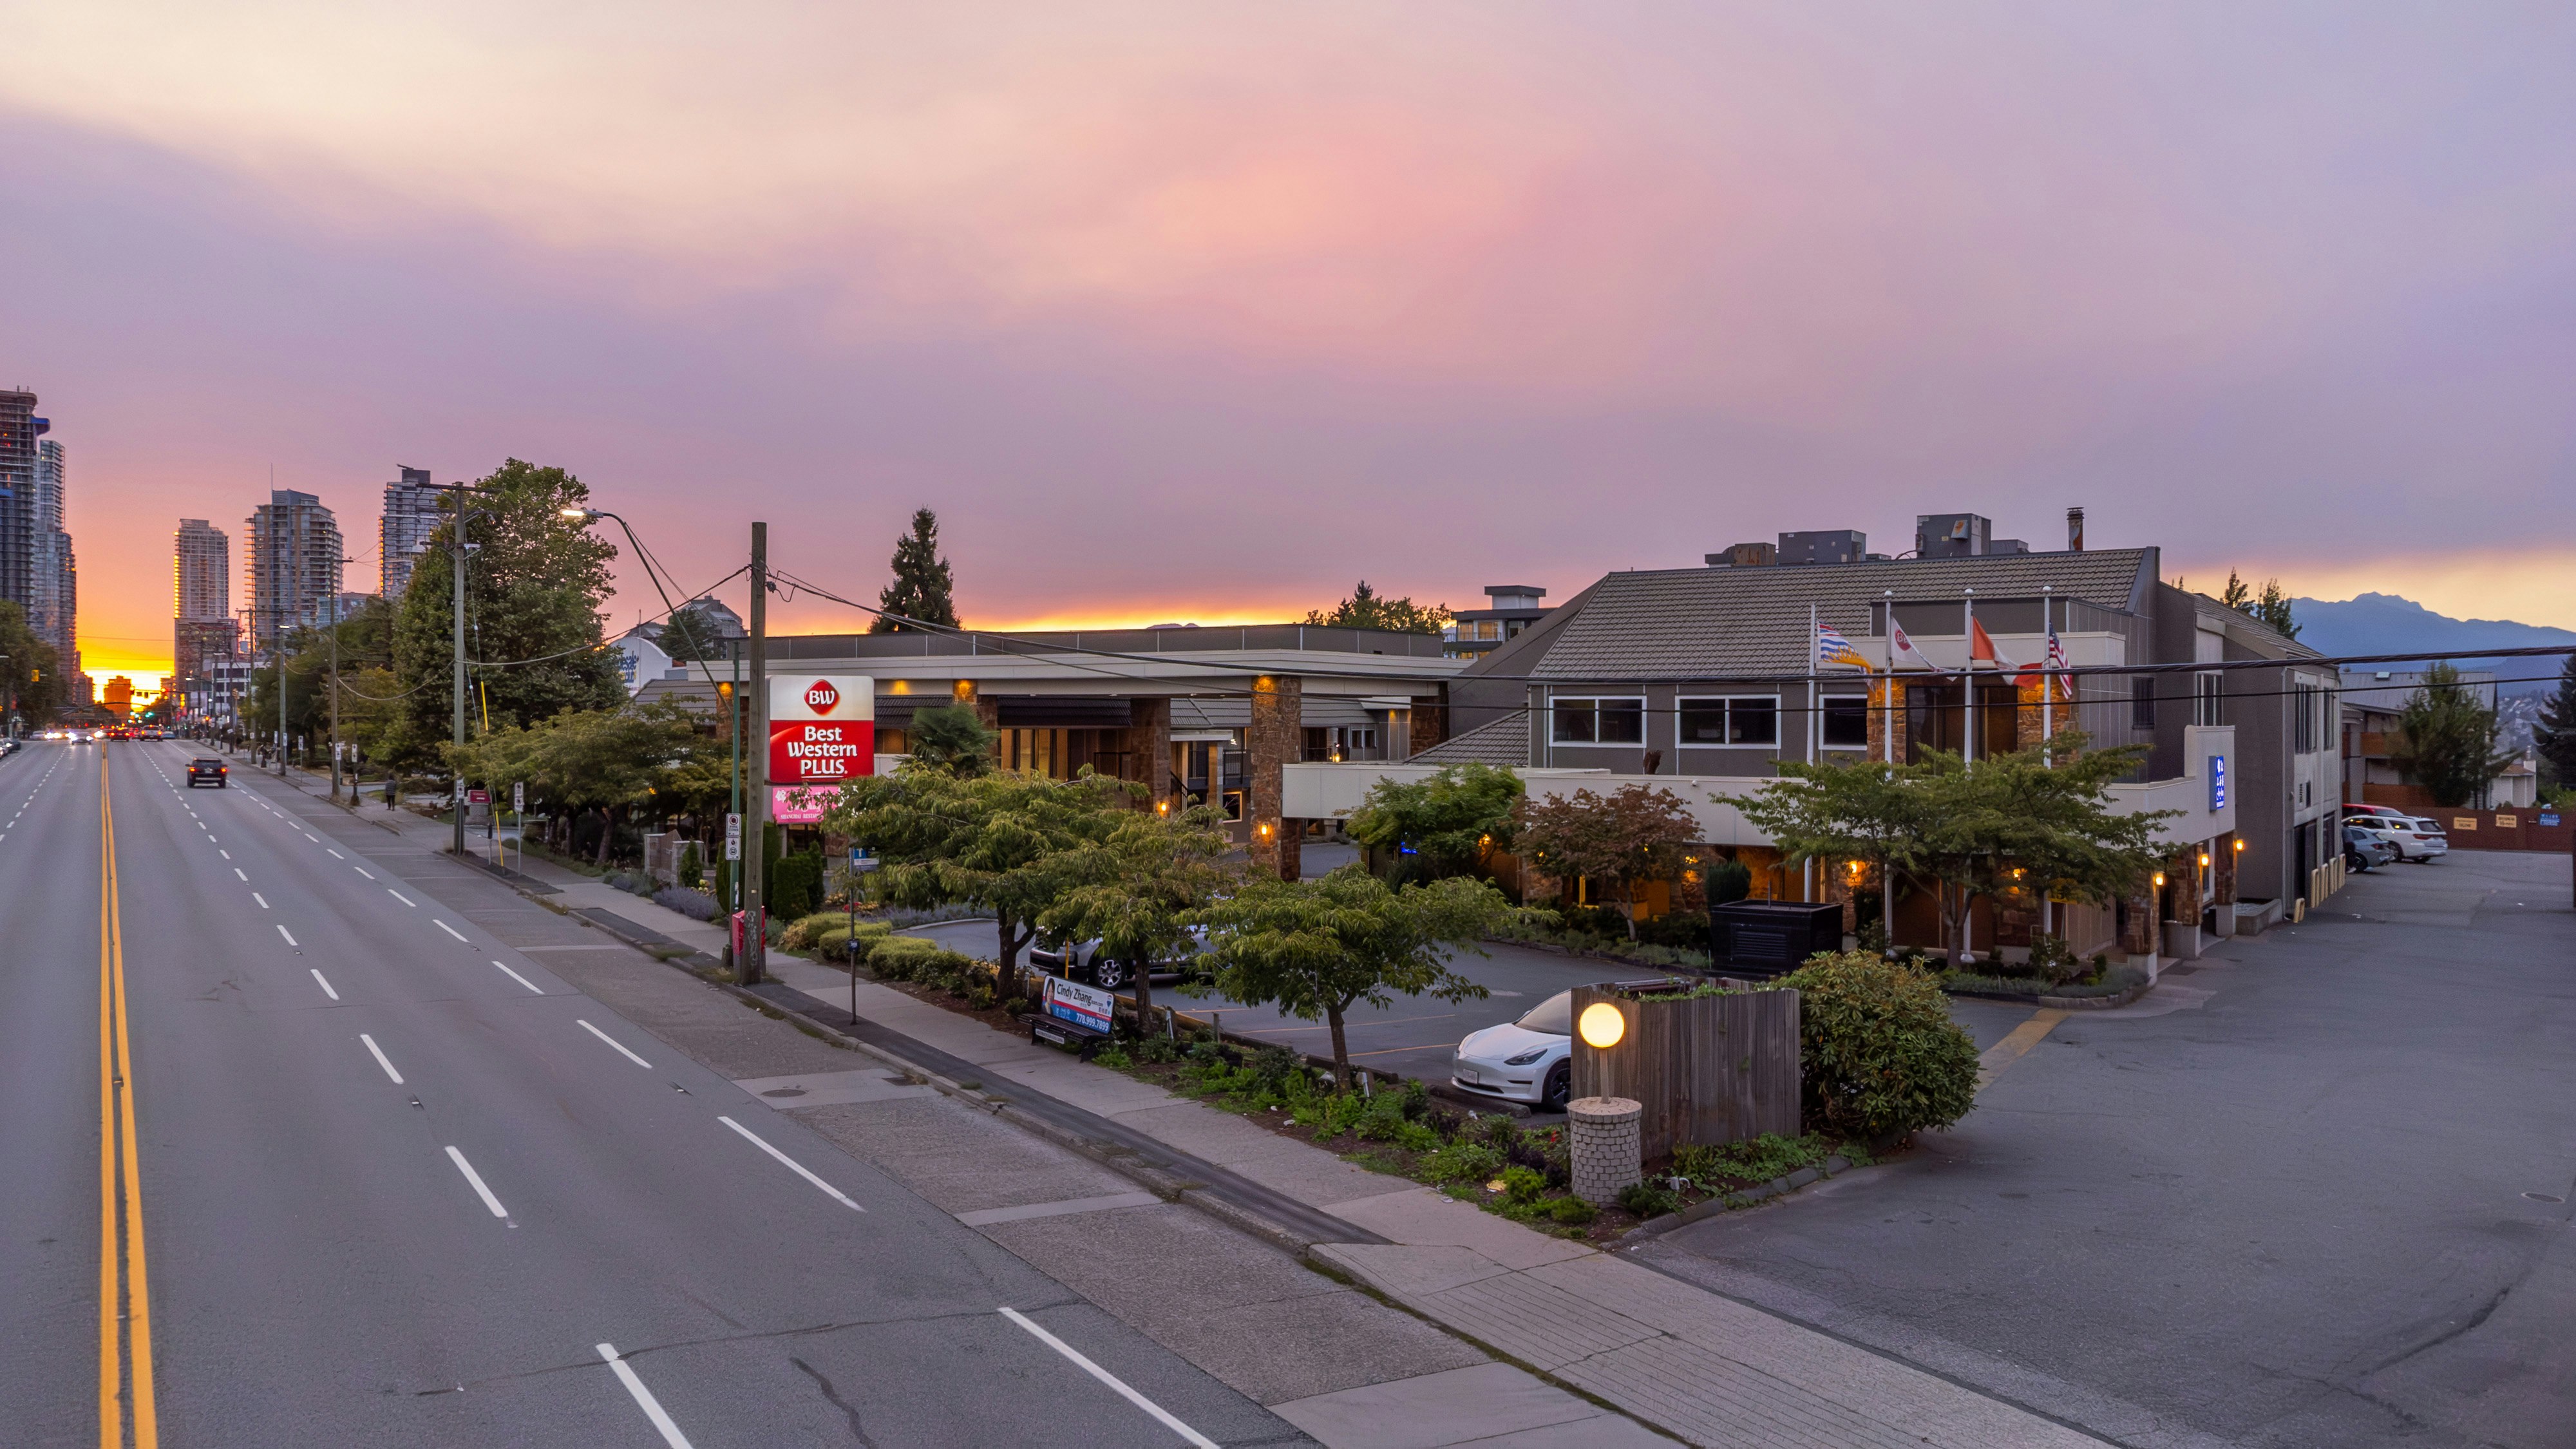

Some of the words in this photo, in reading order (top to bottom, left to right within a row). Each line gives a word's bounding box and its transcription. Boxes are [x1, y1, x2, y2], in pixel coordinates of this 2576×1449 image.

[809, 690, 835, 705] BW
[804, 726, 842, 741] Best
[787, 741, 858, 757] Western
[1057, 983, 1074, 1000] Cindy
[1074, 988, 1092, 1007] Zhang
